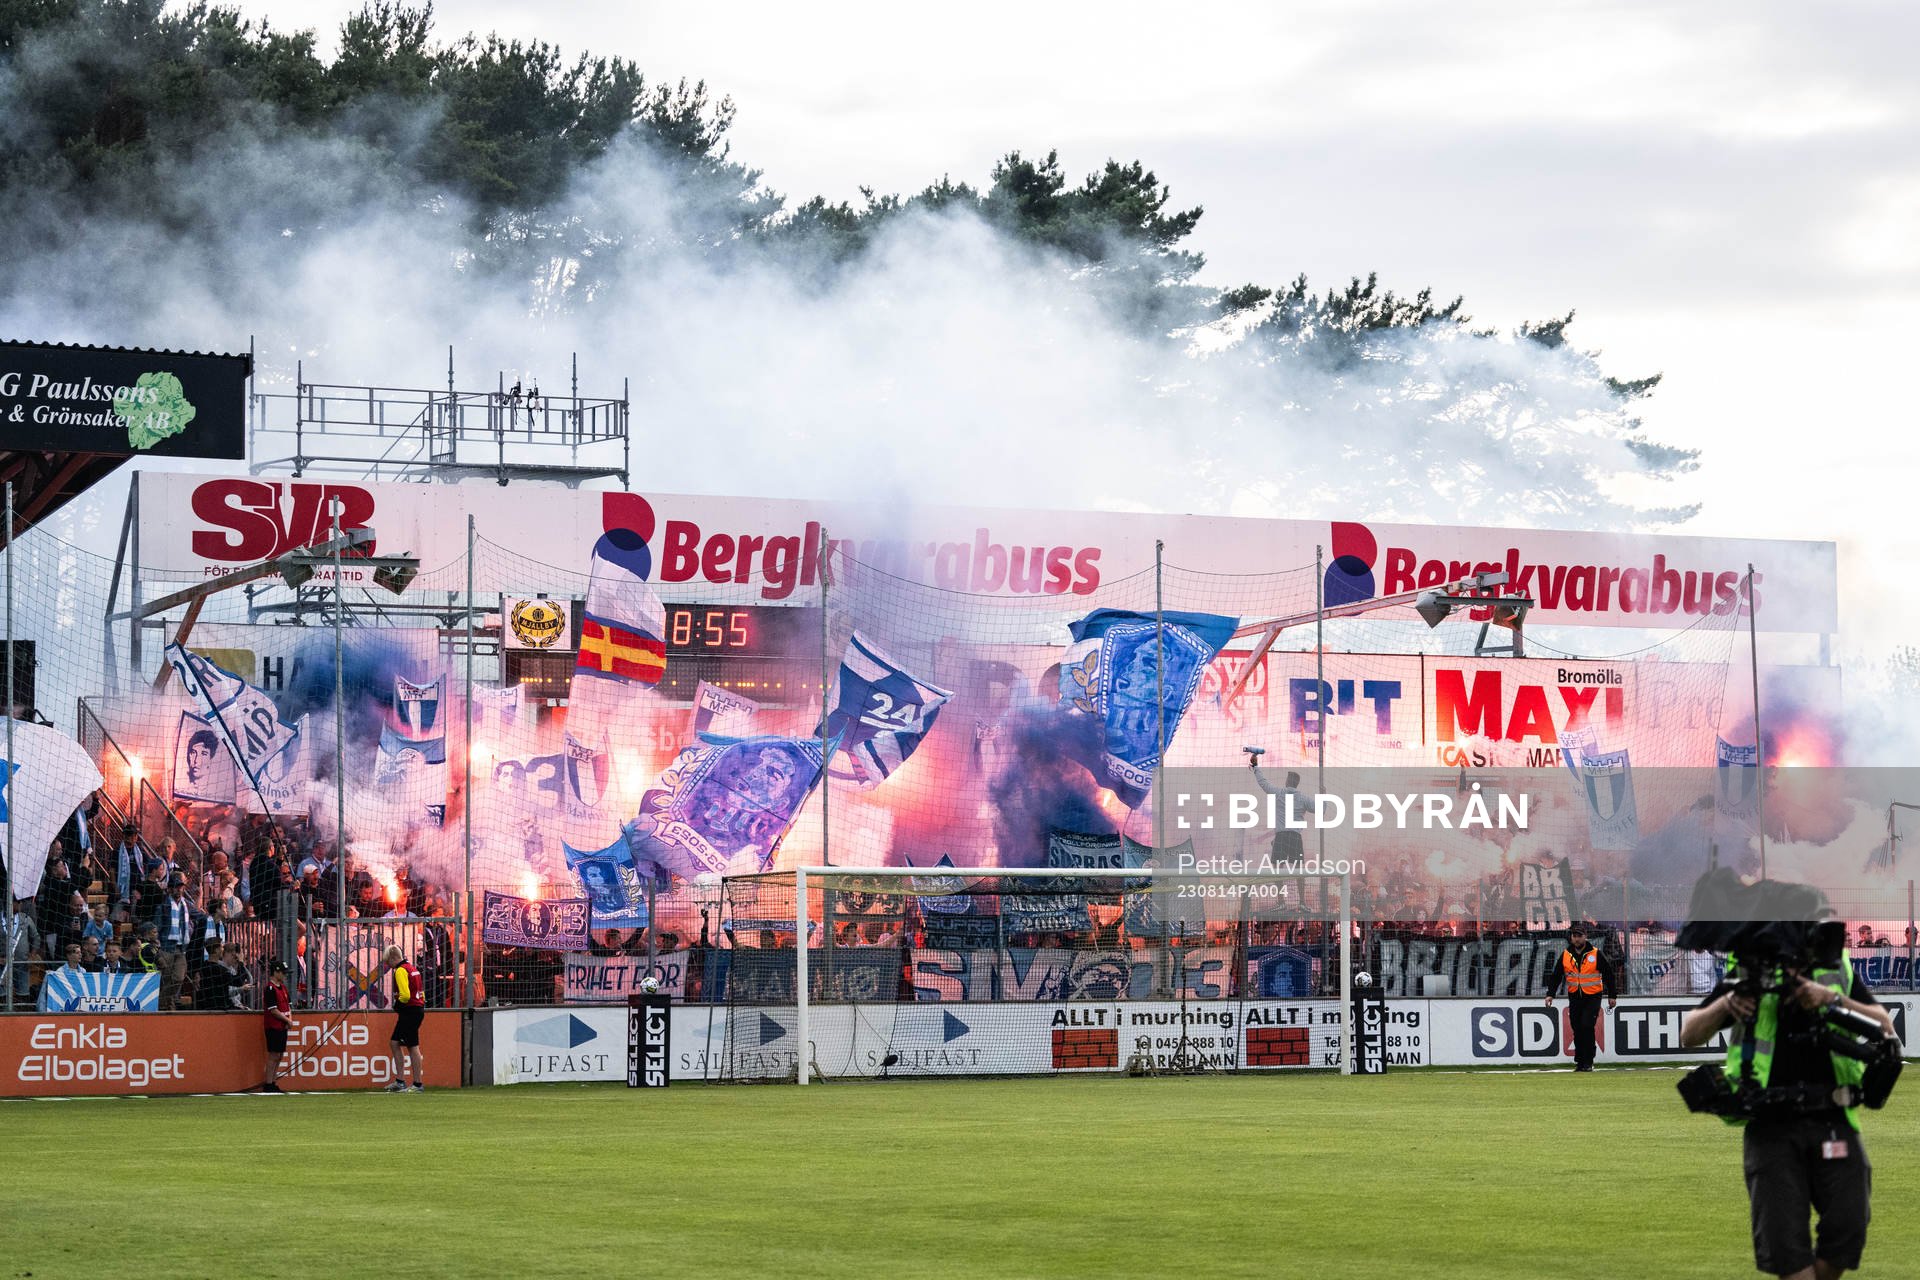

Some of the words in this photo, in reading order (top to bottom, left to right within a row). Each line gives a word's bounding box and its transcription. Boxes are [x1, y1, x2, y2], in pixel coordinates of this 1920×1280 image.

[27, 373, 160, 405] Paulssons
[8, 404, 25, 422] &
[33, 405, 135, 427] Grönsaker
[140, 411, 171, 429] AB
[204, 565, 230, 577] FÖR
[315, 570, 363, 581] RAMTID
[660, 520, 1102, 600] Bergkvrabuss
[1384, 547, 1763, 622] Bergkvarabuss
[662, 612, 749, 648] 8:55
[1557, 668, 1623, 685] Bromölla
[867, 692, 916, 724] 24
[1435, 669, 1624, 744] MAXI
[256, 778, 291, 798] almö
[567, 963, 628, 991] FRIHET
[631, 960, 681, 991] FÖR
[1380, 938, 1604, 996] BRIGAD
[1051, 1008, 1108, 1027] ALLT
[1116, 1008, 1123, 1026] i
[1245, 1007, 1300, 1025] ALLT
[1307, 1007, 1313, 1025] i
[1322, 1006, 1421, 1028] ming
[30, 1023, 127, 1049] Enkla
[286, 1020, 369, 1046] Enkla
[628, 1005, 639, 1087] SELECT
[645, 1005, 666, 1087] SELECT
[1219, 1036, 1234, 1049] 10
[1363, 998, 1383, 1074] SELECT
[1407, 1035, 1421, 1048] 10
[17, 1053, 185, 1087] Elbolaget
[277, 1051, 423, 1083] Elbolage
[1134, 1053, 1236, 1068] ARLSHAMN
